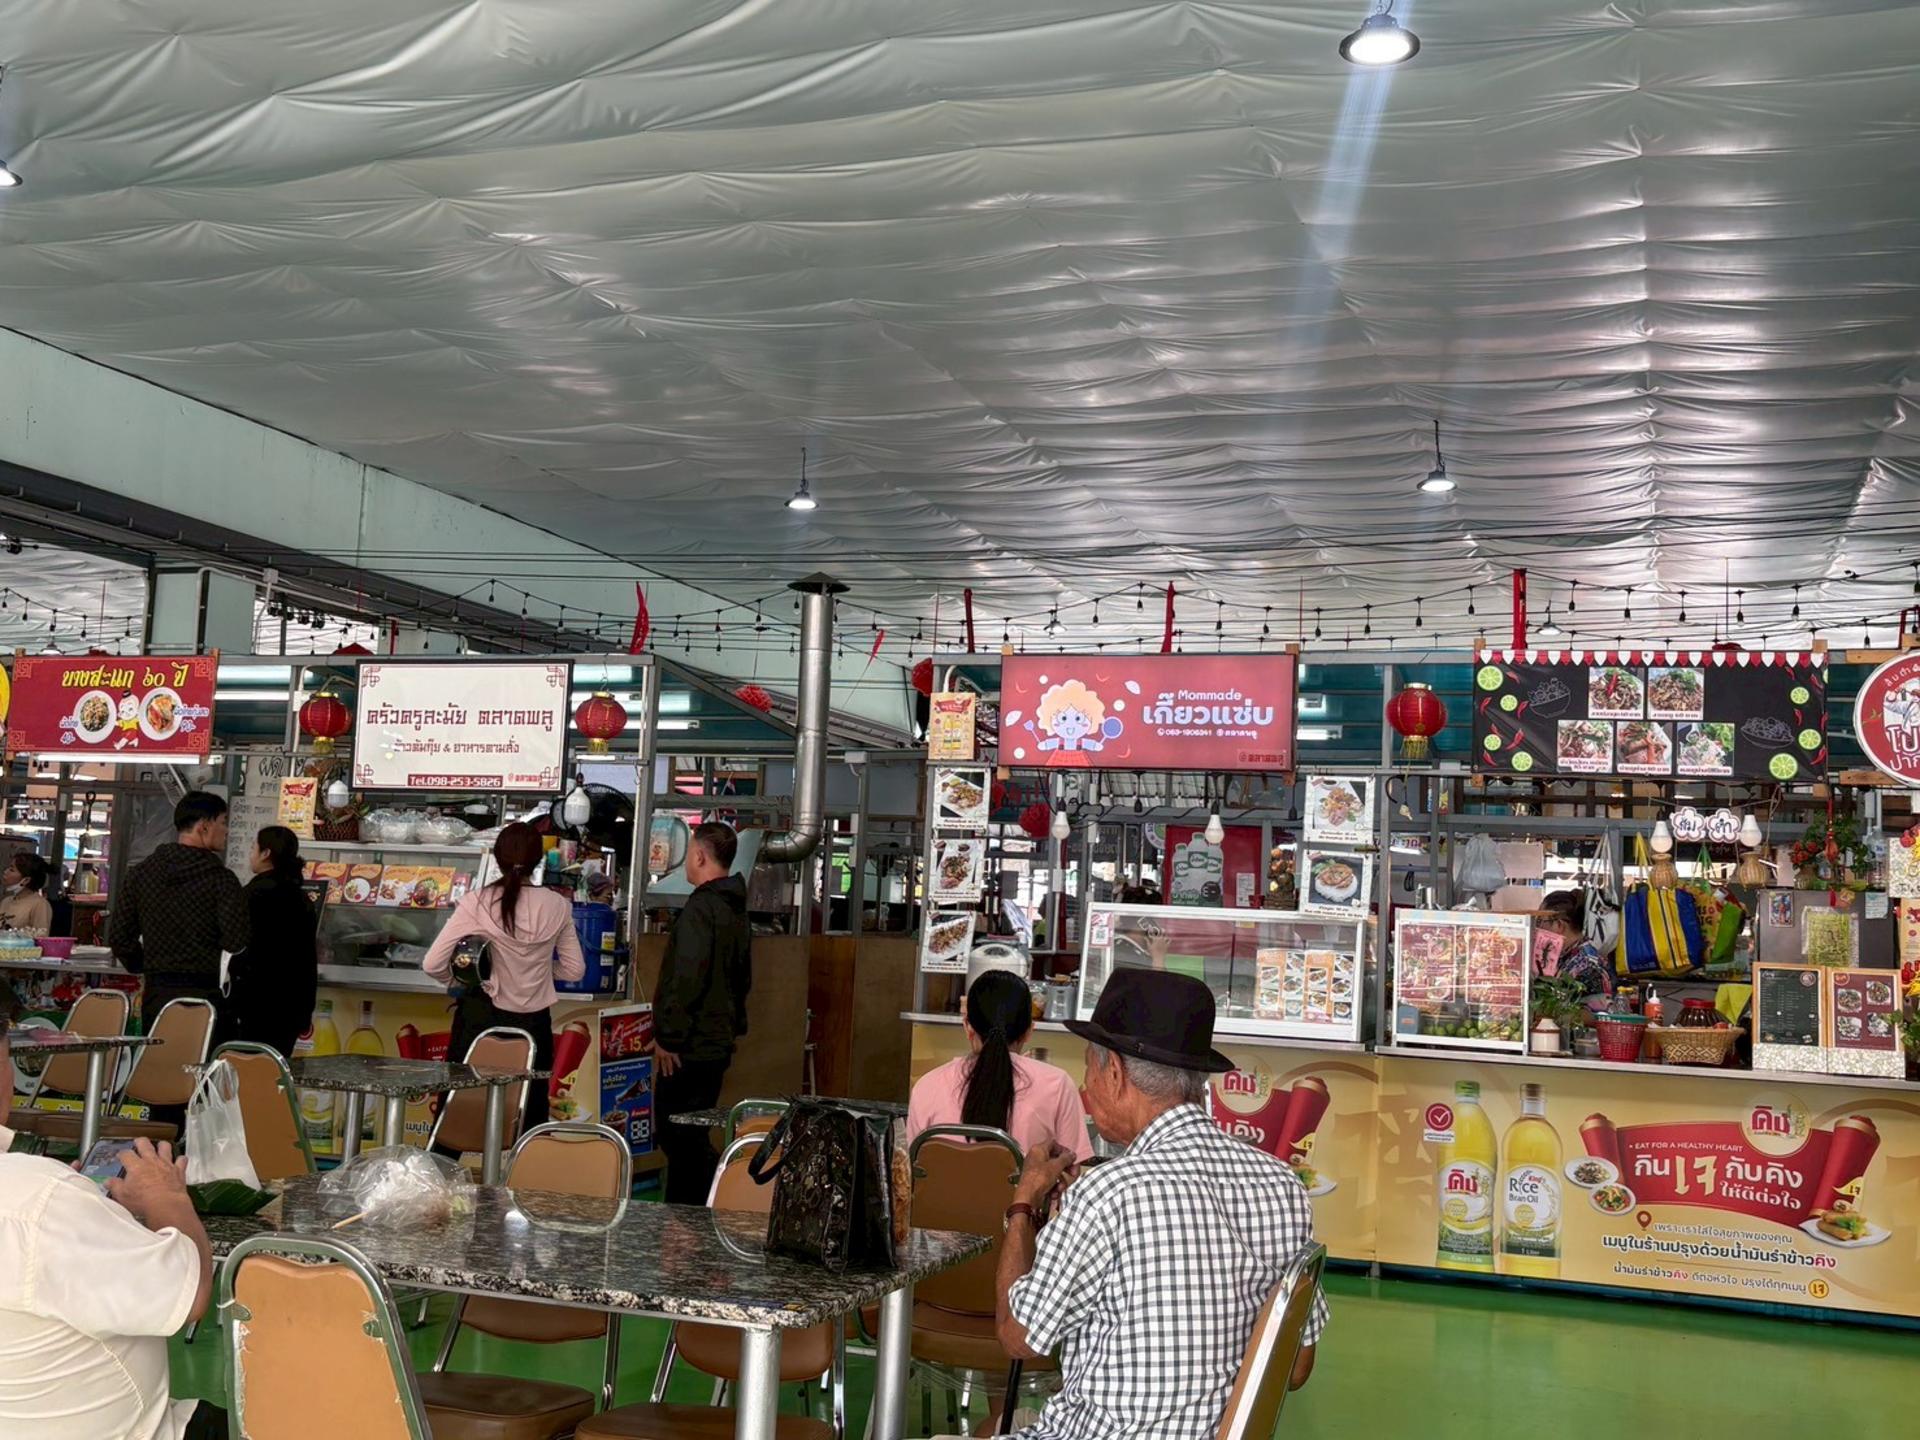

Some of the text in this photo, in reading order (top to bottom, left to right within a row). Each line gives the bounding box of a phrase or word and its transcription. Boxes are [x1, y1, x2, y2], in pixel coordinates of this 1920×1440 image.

[62, 664, 135, 688] บางสะแก
[171, 661, 189, 688] ปี
[1178, 688, 1242, 701] Mommade
[478, 709, 554, 732] ตลาดพลู
[410, 775, 501, 787] Tel.098-253-5826
[1751, 1105, 1791, 1135] คิง
[1635, 1142, 1650, 1150] EAT
[1652, 1142, 1669, 1150] FOR
[1678, 1142, 1714, 1151] HEALTHY
[1715, 1143, 1744, 1153] HEART
[1635, 1153, 1671, 1177] กิน
[1528, 1194, 1539, 1204] Oil
[1719, 1180, 1802, 1211] ให้ดีต่อใจ
